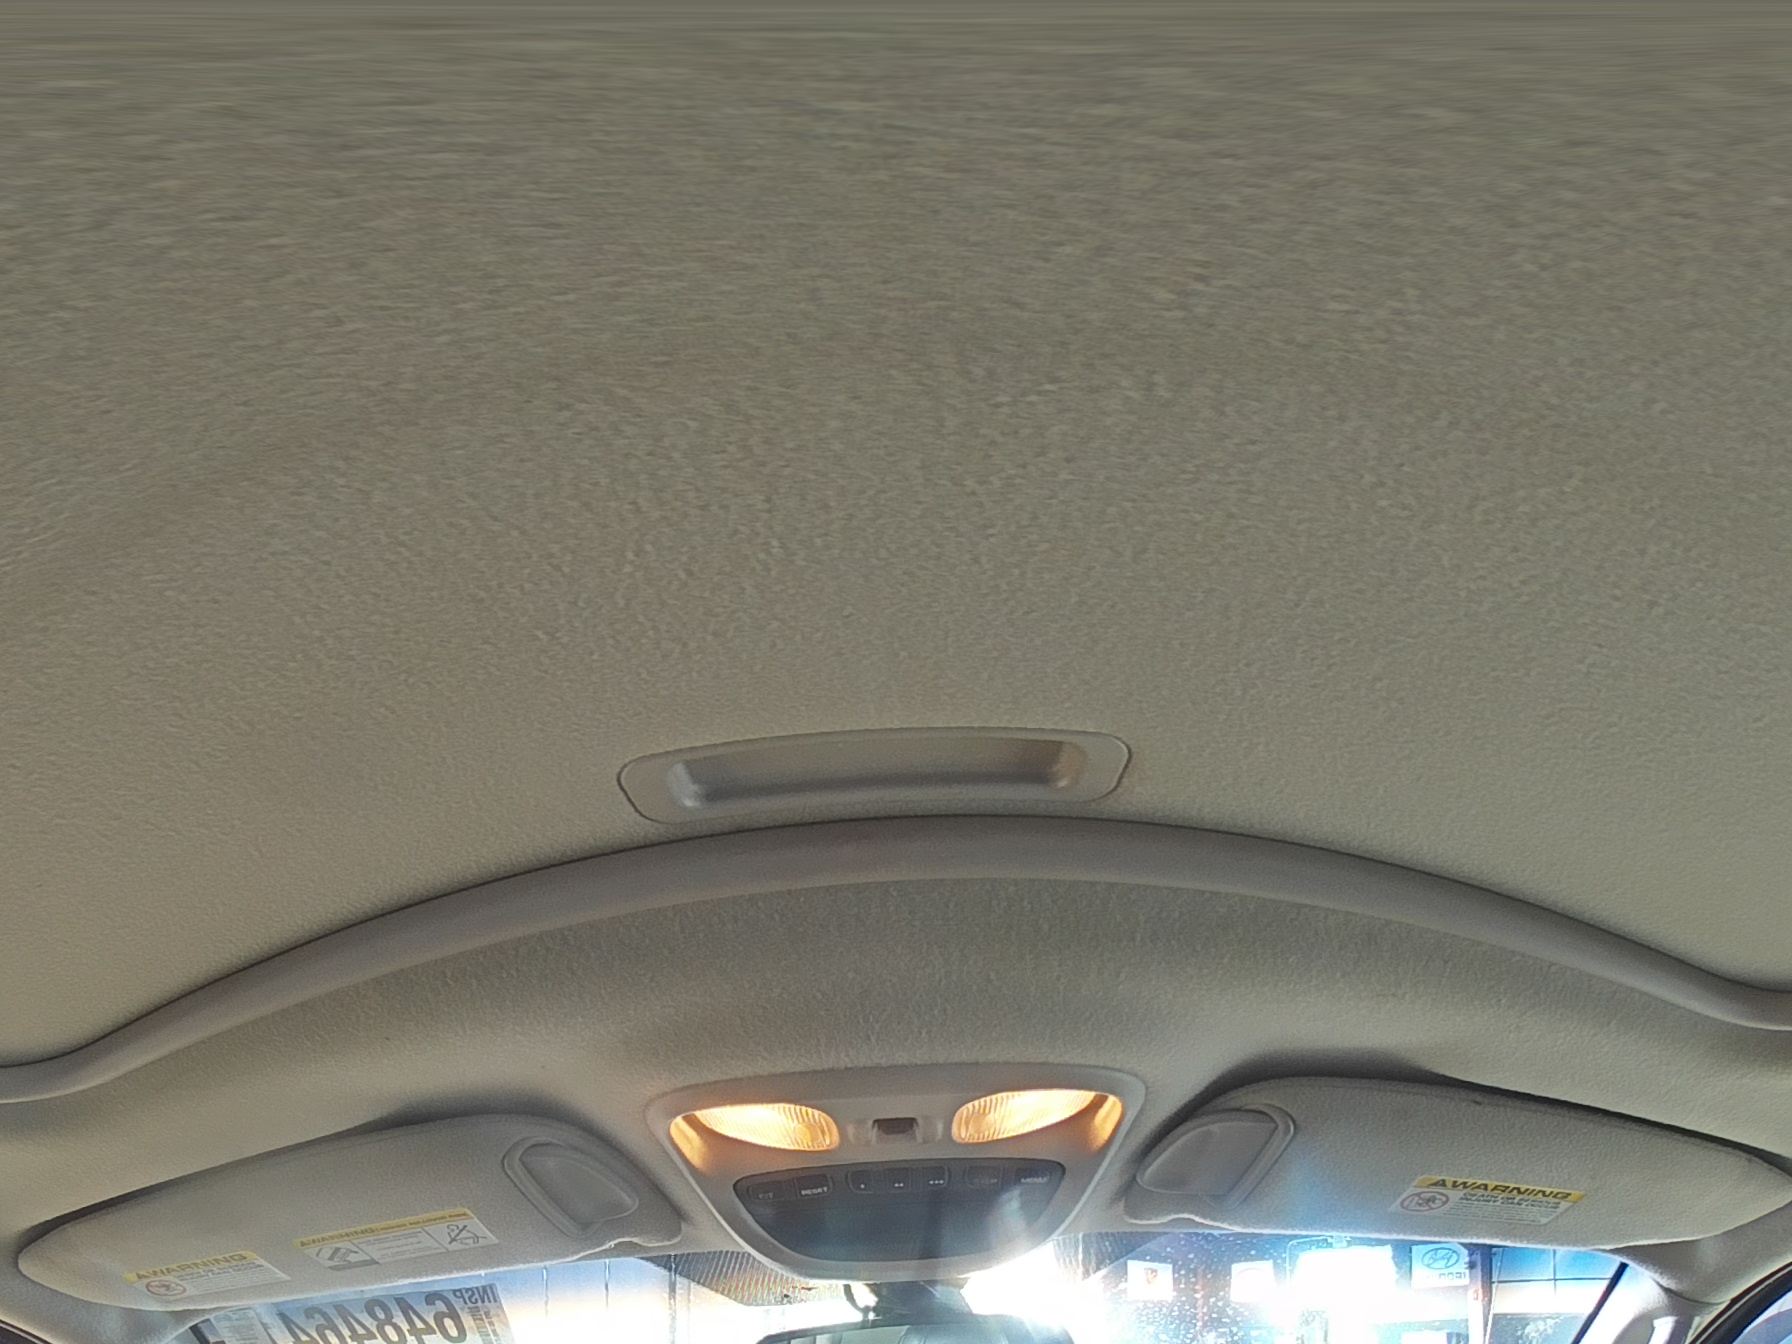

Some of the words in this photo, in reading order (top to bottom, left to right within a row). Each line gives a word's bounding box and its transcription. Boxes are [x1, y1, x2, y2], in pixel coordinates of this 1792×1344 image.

[801, 1186, 828, 1196] RESET
[1450, 1180, 1573, 1200] WARNING
[148, 1253, 248, 1279] WARNING
